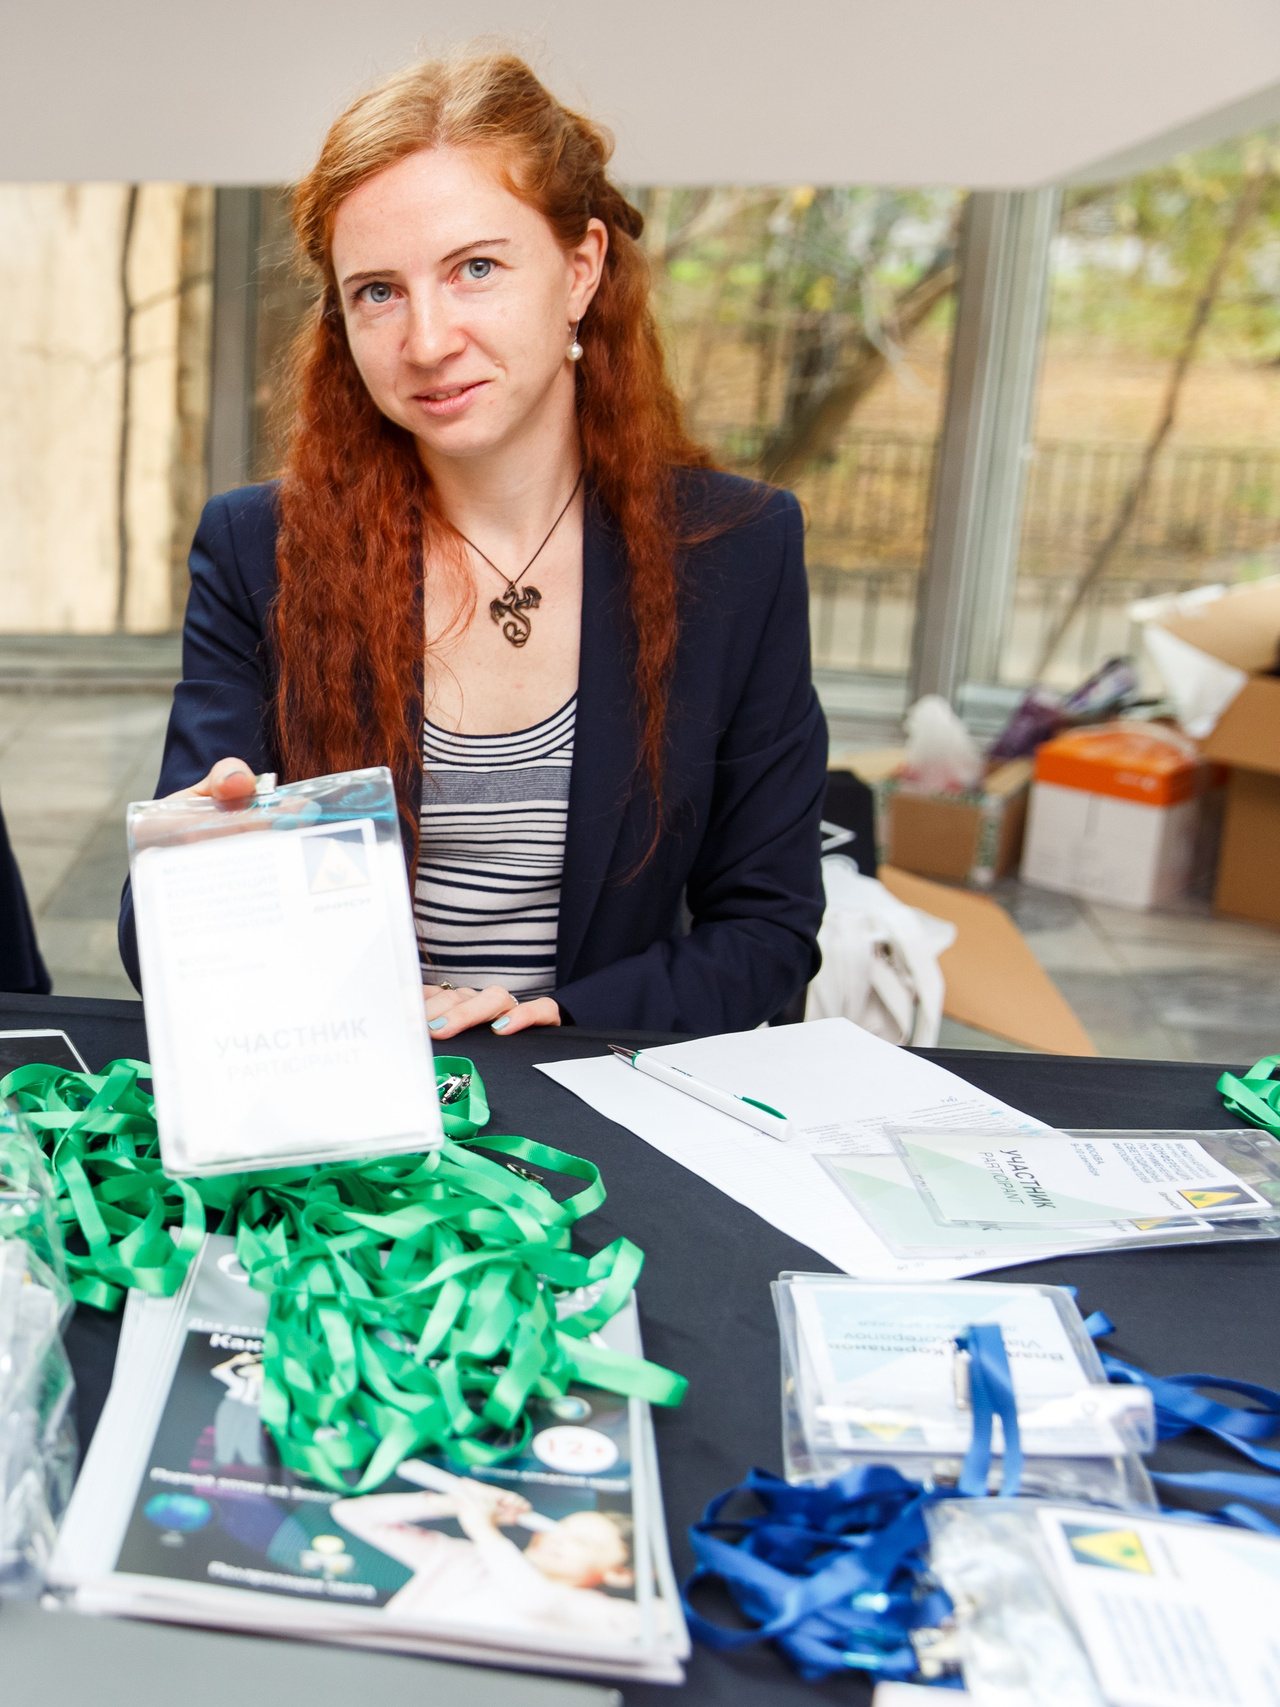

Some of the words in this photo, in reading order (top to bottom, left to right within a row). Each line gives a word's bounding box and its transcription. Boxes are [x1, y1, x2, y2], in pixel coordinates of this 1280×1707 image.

[165, 873, 279, 900] КОНФЕРЕНЦИЯ
[215, 1017, 369, 1058] УЧАСТНИК
[227, 1047, 362, 1081] PARTICIPANT
[1083, 1142, 1105, 1165] МОСКВА
[1150, 1142, 1194, 1181] КОНФЕРЕНЦИЯ
[978, 1151, 1025, 1206] PARTICIPANT
[1000, 1149, 1057, 1210] УЧАСТНИК
